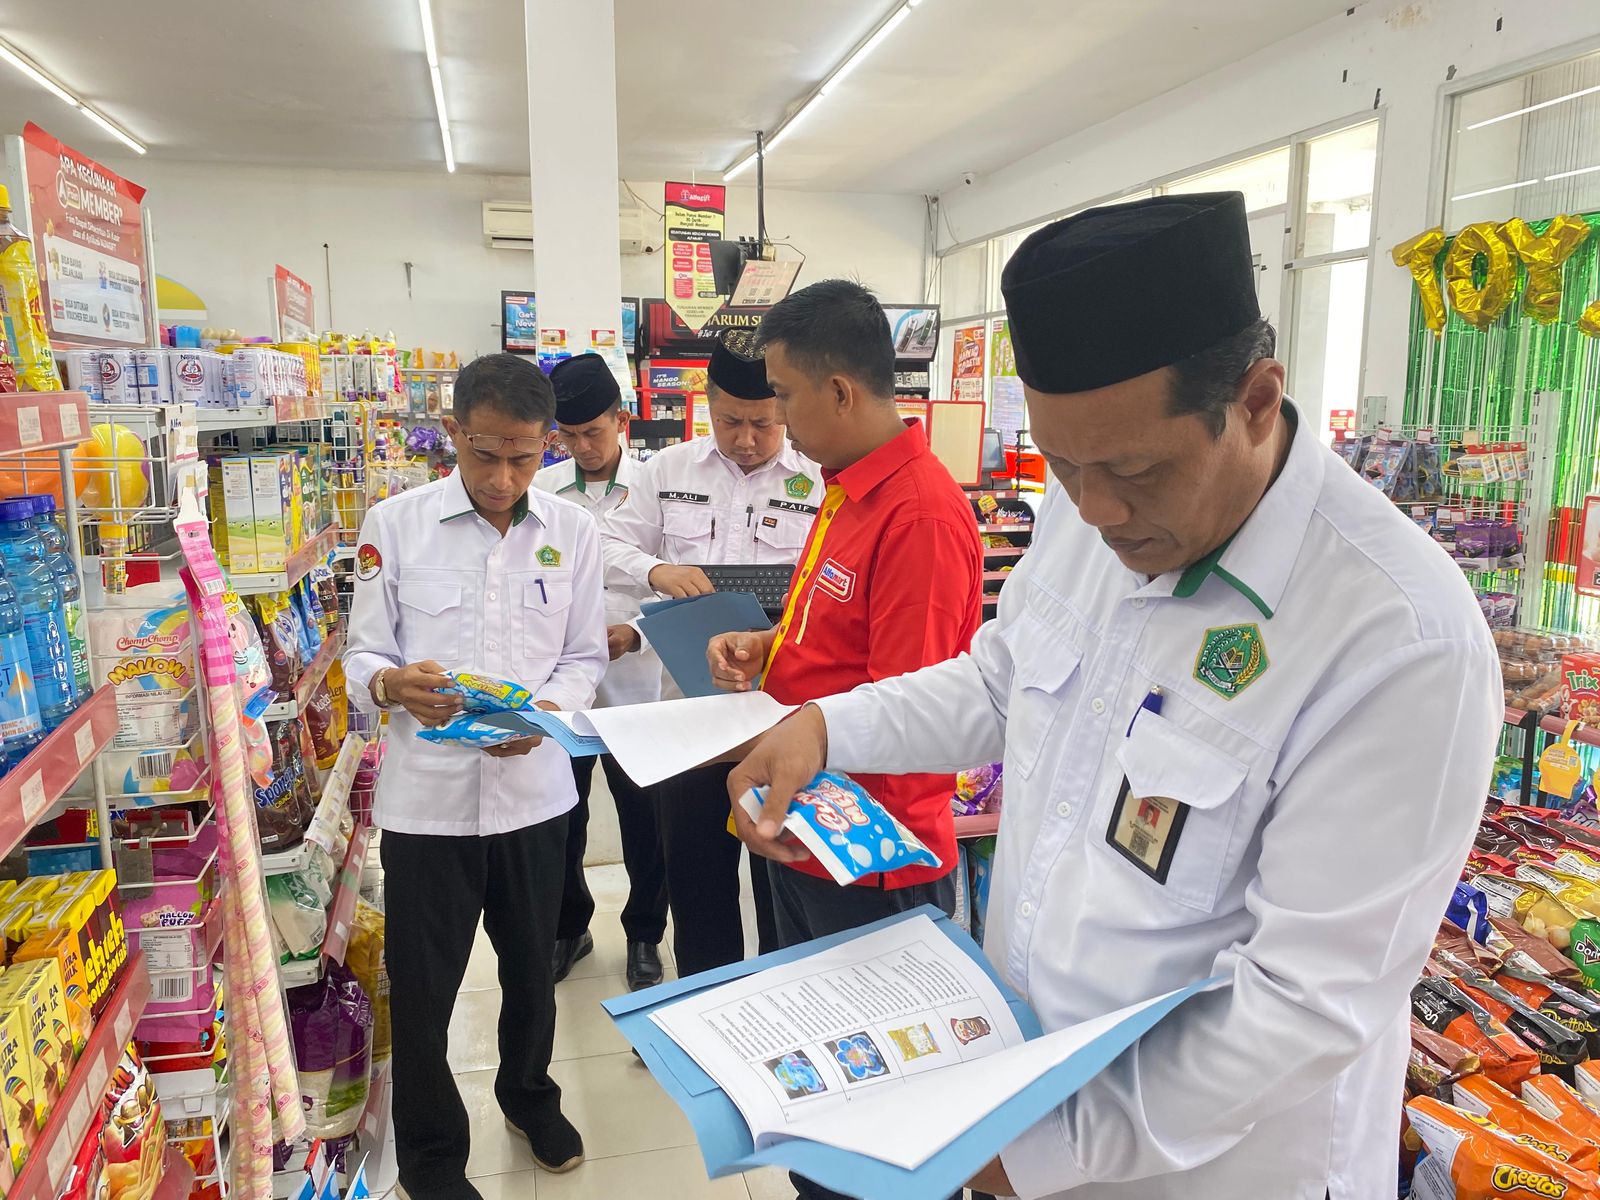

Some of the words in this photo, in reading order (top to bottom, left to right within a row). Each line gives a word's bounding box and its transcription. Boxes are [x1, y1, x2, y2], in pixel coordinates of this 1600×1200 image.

[653, 376, 679, 384] MANGO
[668, 491, 681, 500] M.
[682, 493, 699, 501] ALI
[780, 501, 810, 511] PAIF
[107, 656, 186, 686] MALLOW
[1565, 668, 1599, 691] Trix
[161, 918, 191, 927] PUFF
[1493, 1163, 1567, 1198] Cheetos
